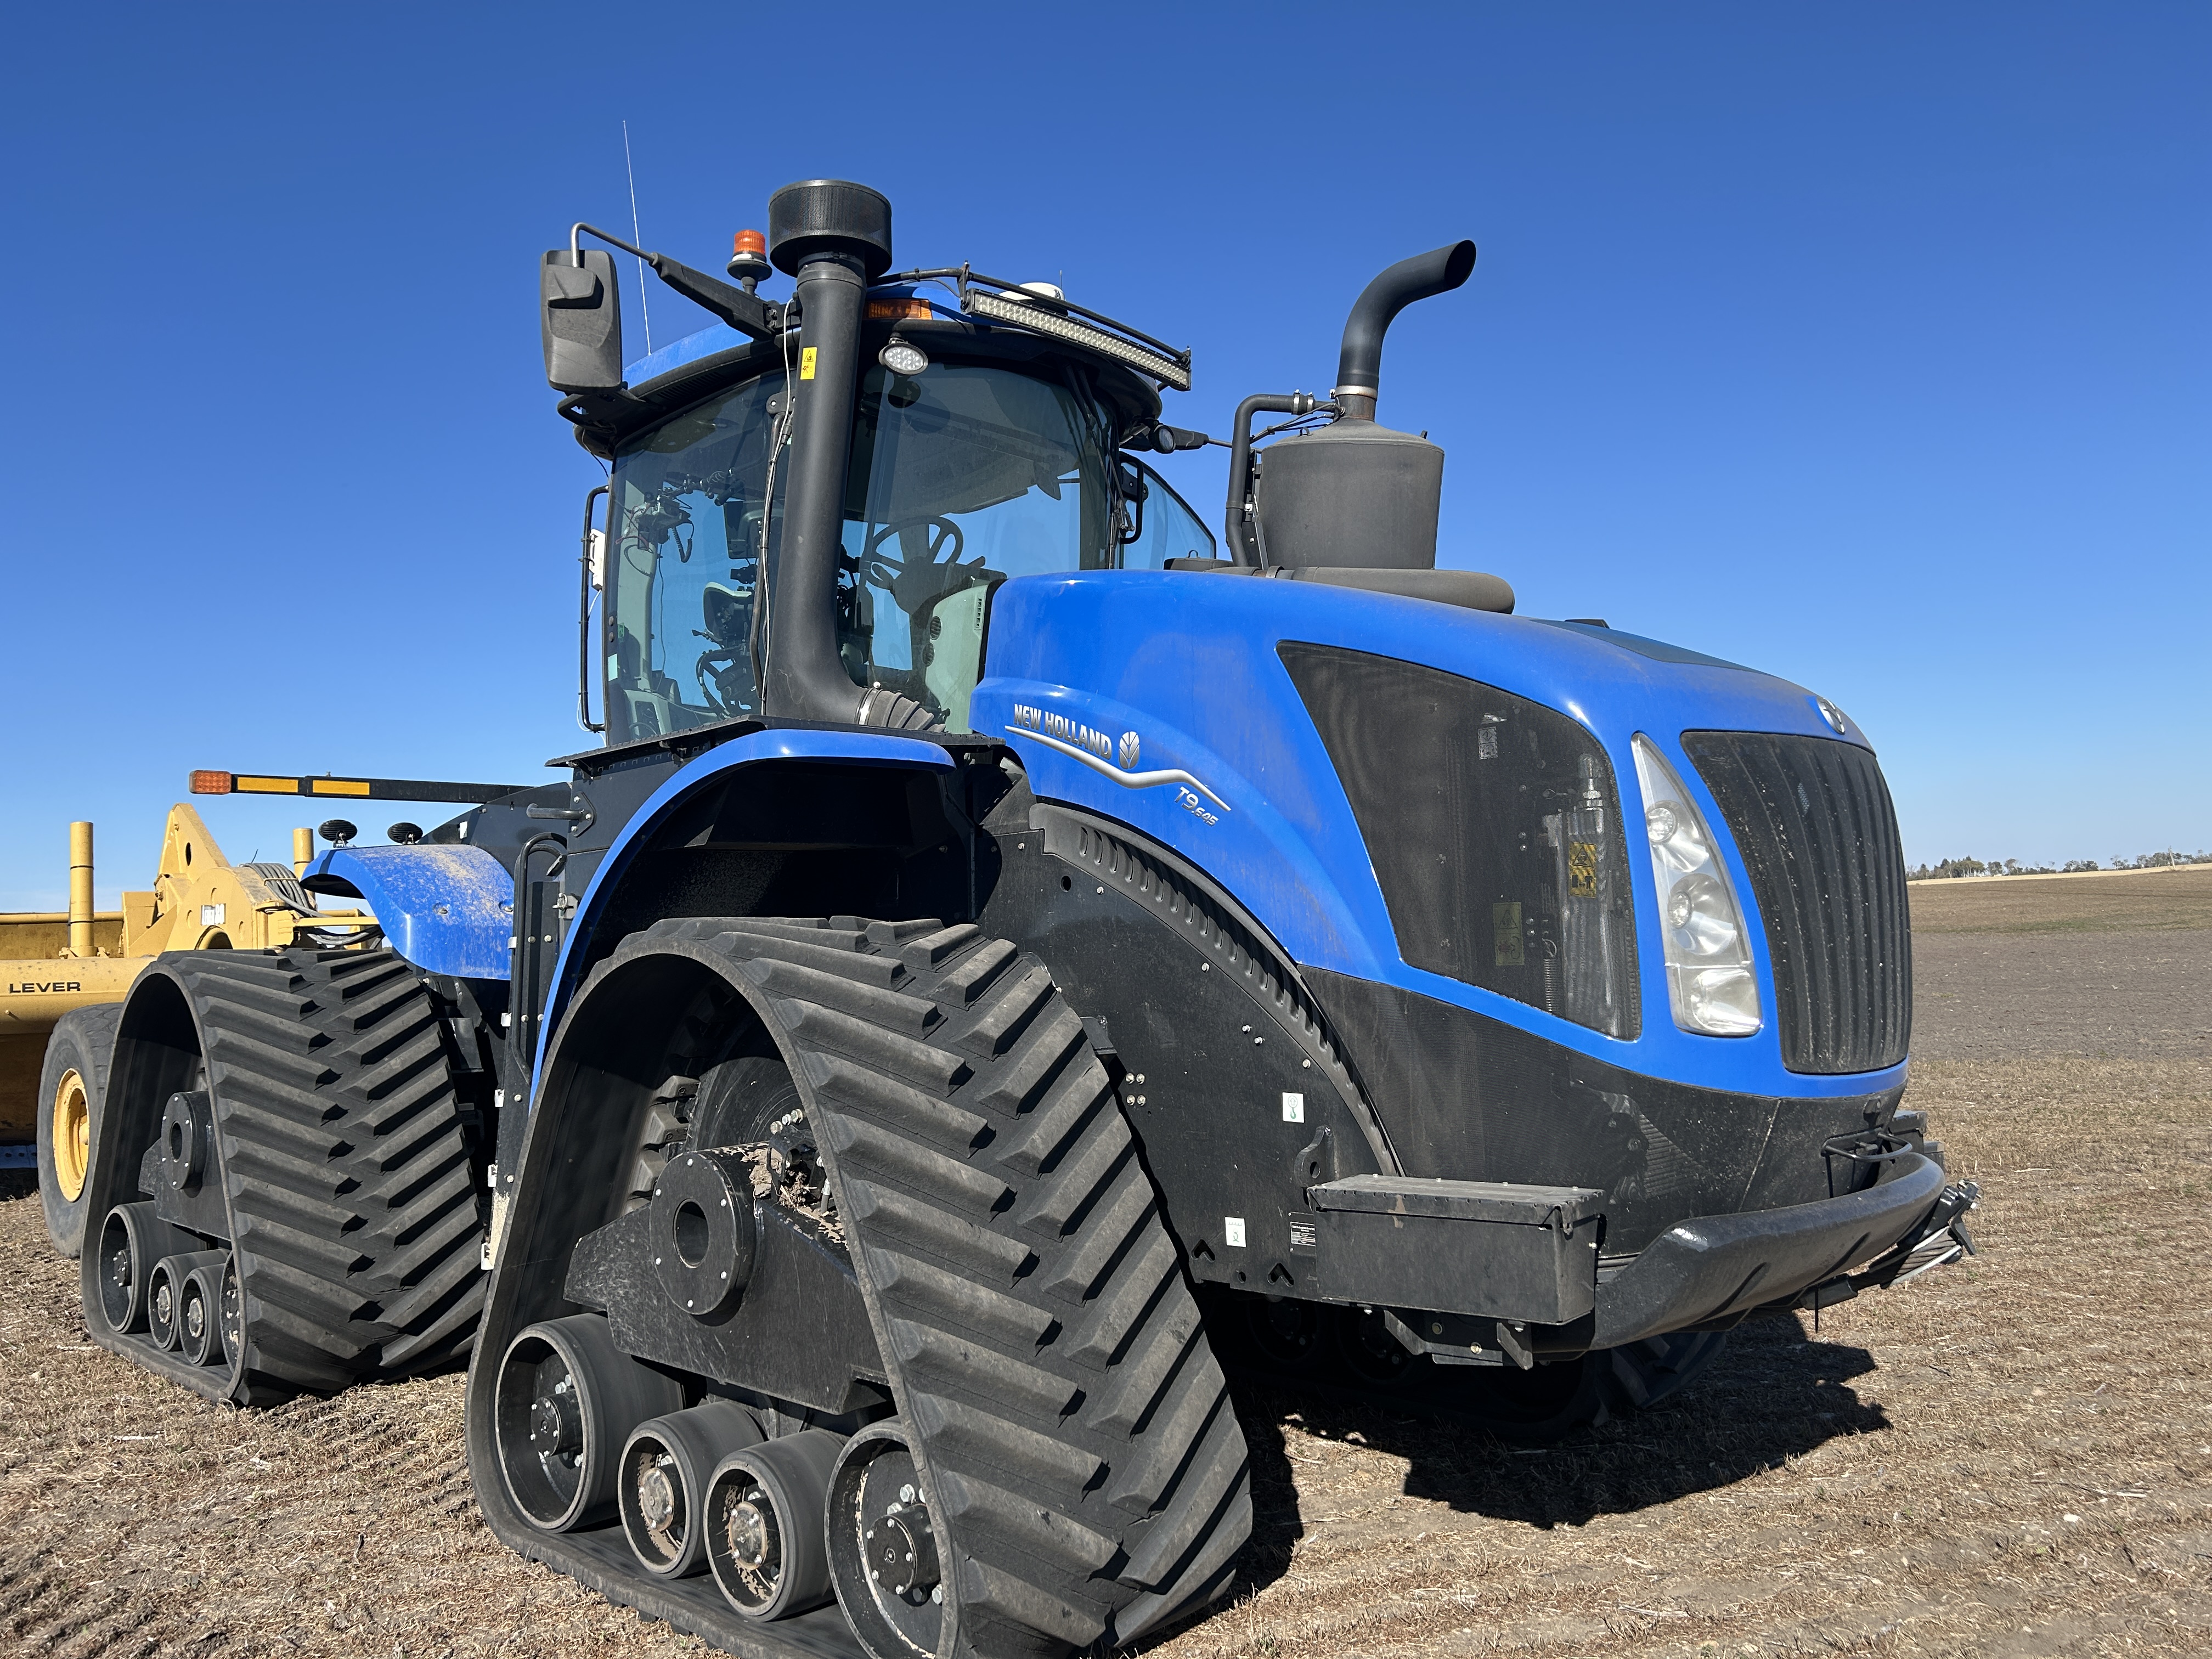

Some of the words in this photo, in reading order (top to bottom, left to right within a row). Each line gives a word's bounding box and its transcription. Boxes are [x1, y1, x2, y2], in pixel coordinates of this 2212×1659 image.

[1014, 703, 1041, 730] NEW
[1045, 711, 1112, 760] HOLLAND
[1175, 786, 1219, 827] T9.645
[9, 982, 81, 993] LEVER
